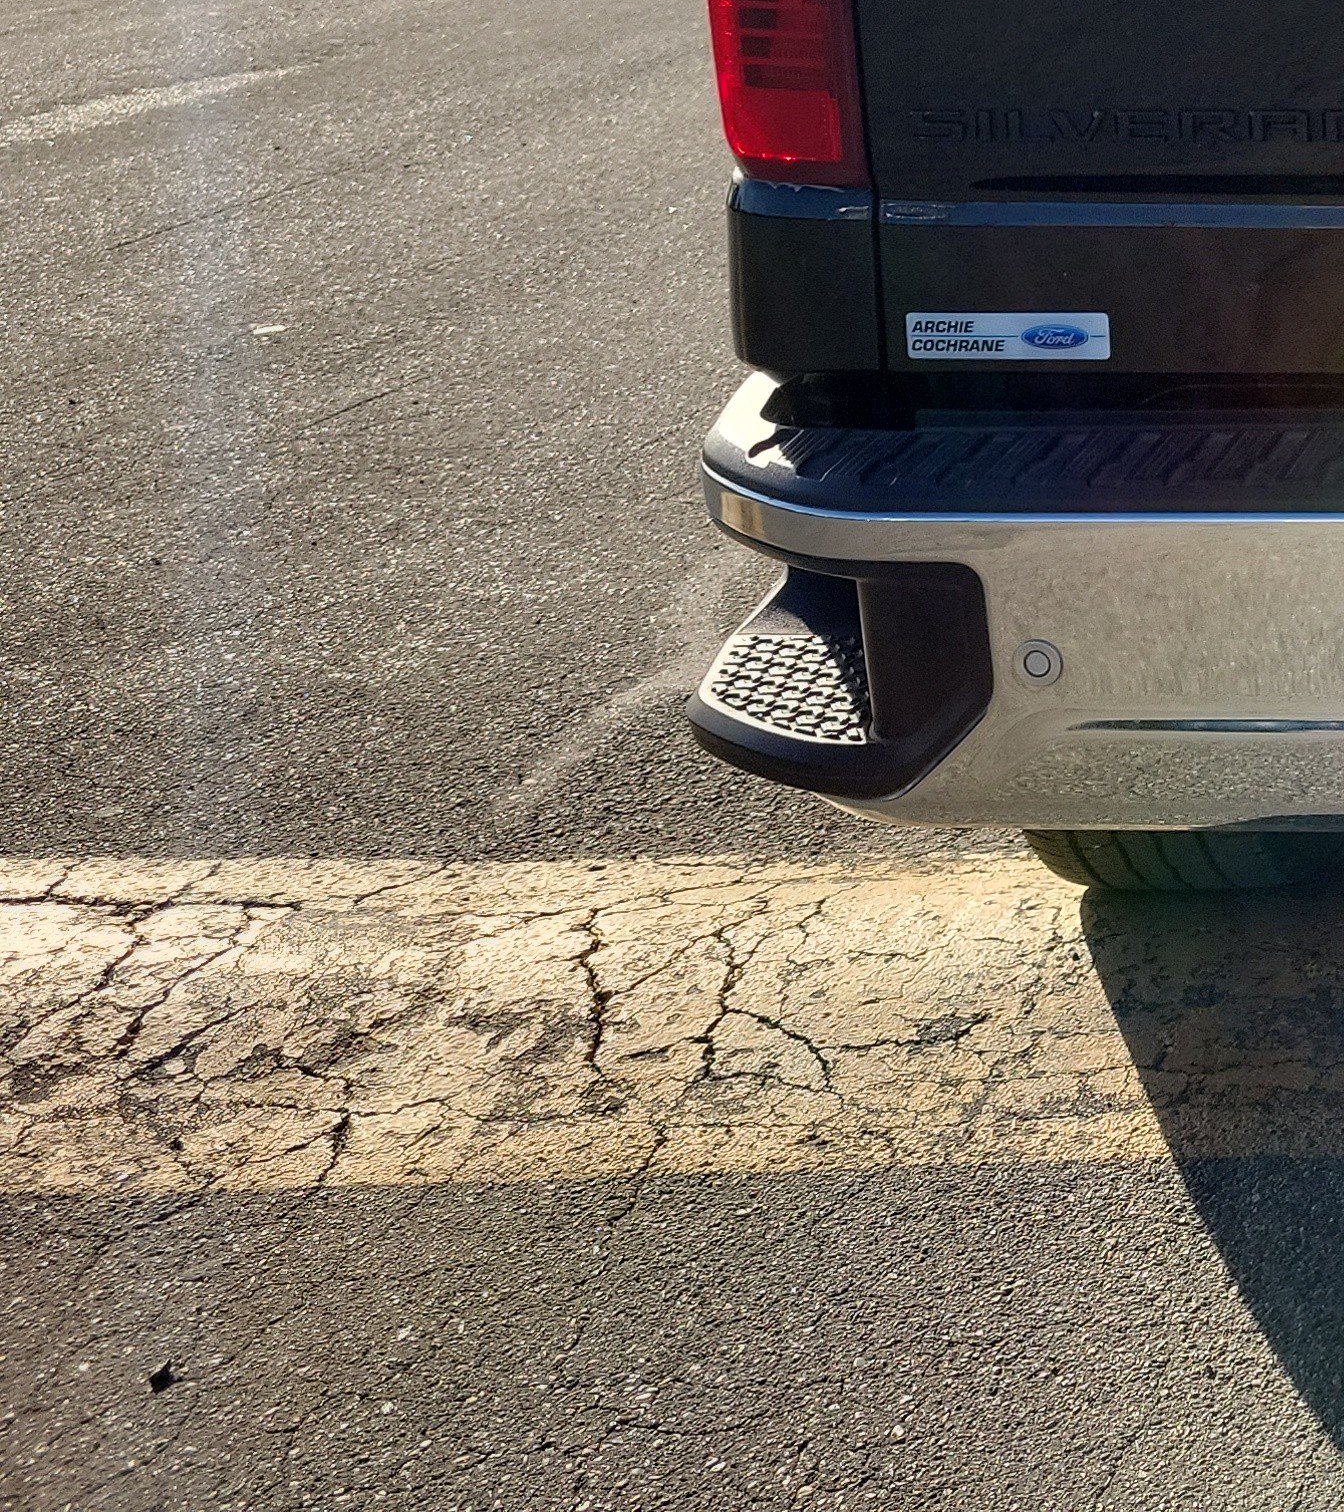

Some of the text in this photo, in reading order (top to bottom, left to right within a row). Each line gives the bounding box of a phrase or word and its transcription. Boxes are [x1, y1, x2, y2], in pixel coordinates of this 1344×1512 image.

[911, 320, 974, 334] ARCHIE
[1034, 327, 1075, 346] Ford
[911, 339, 1005, 353] COCHRANE
